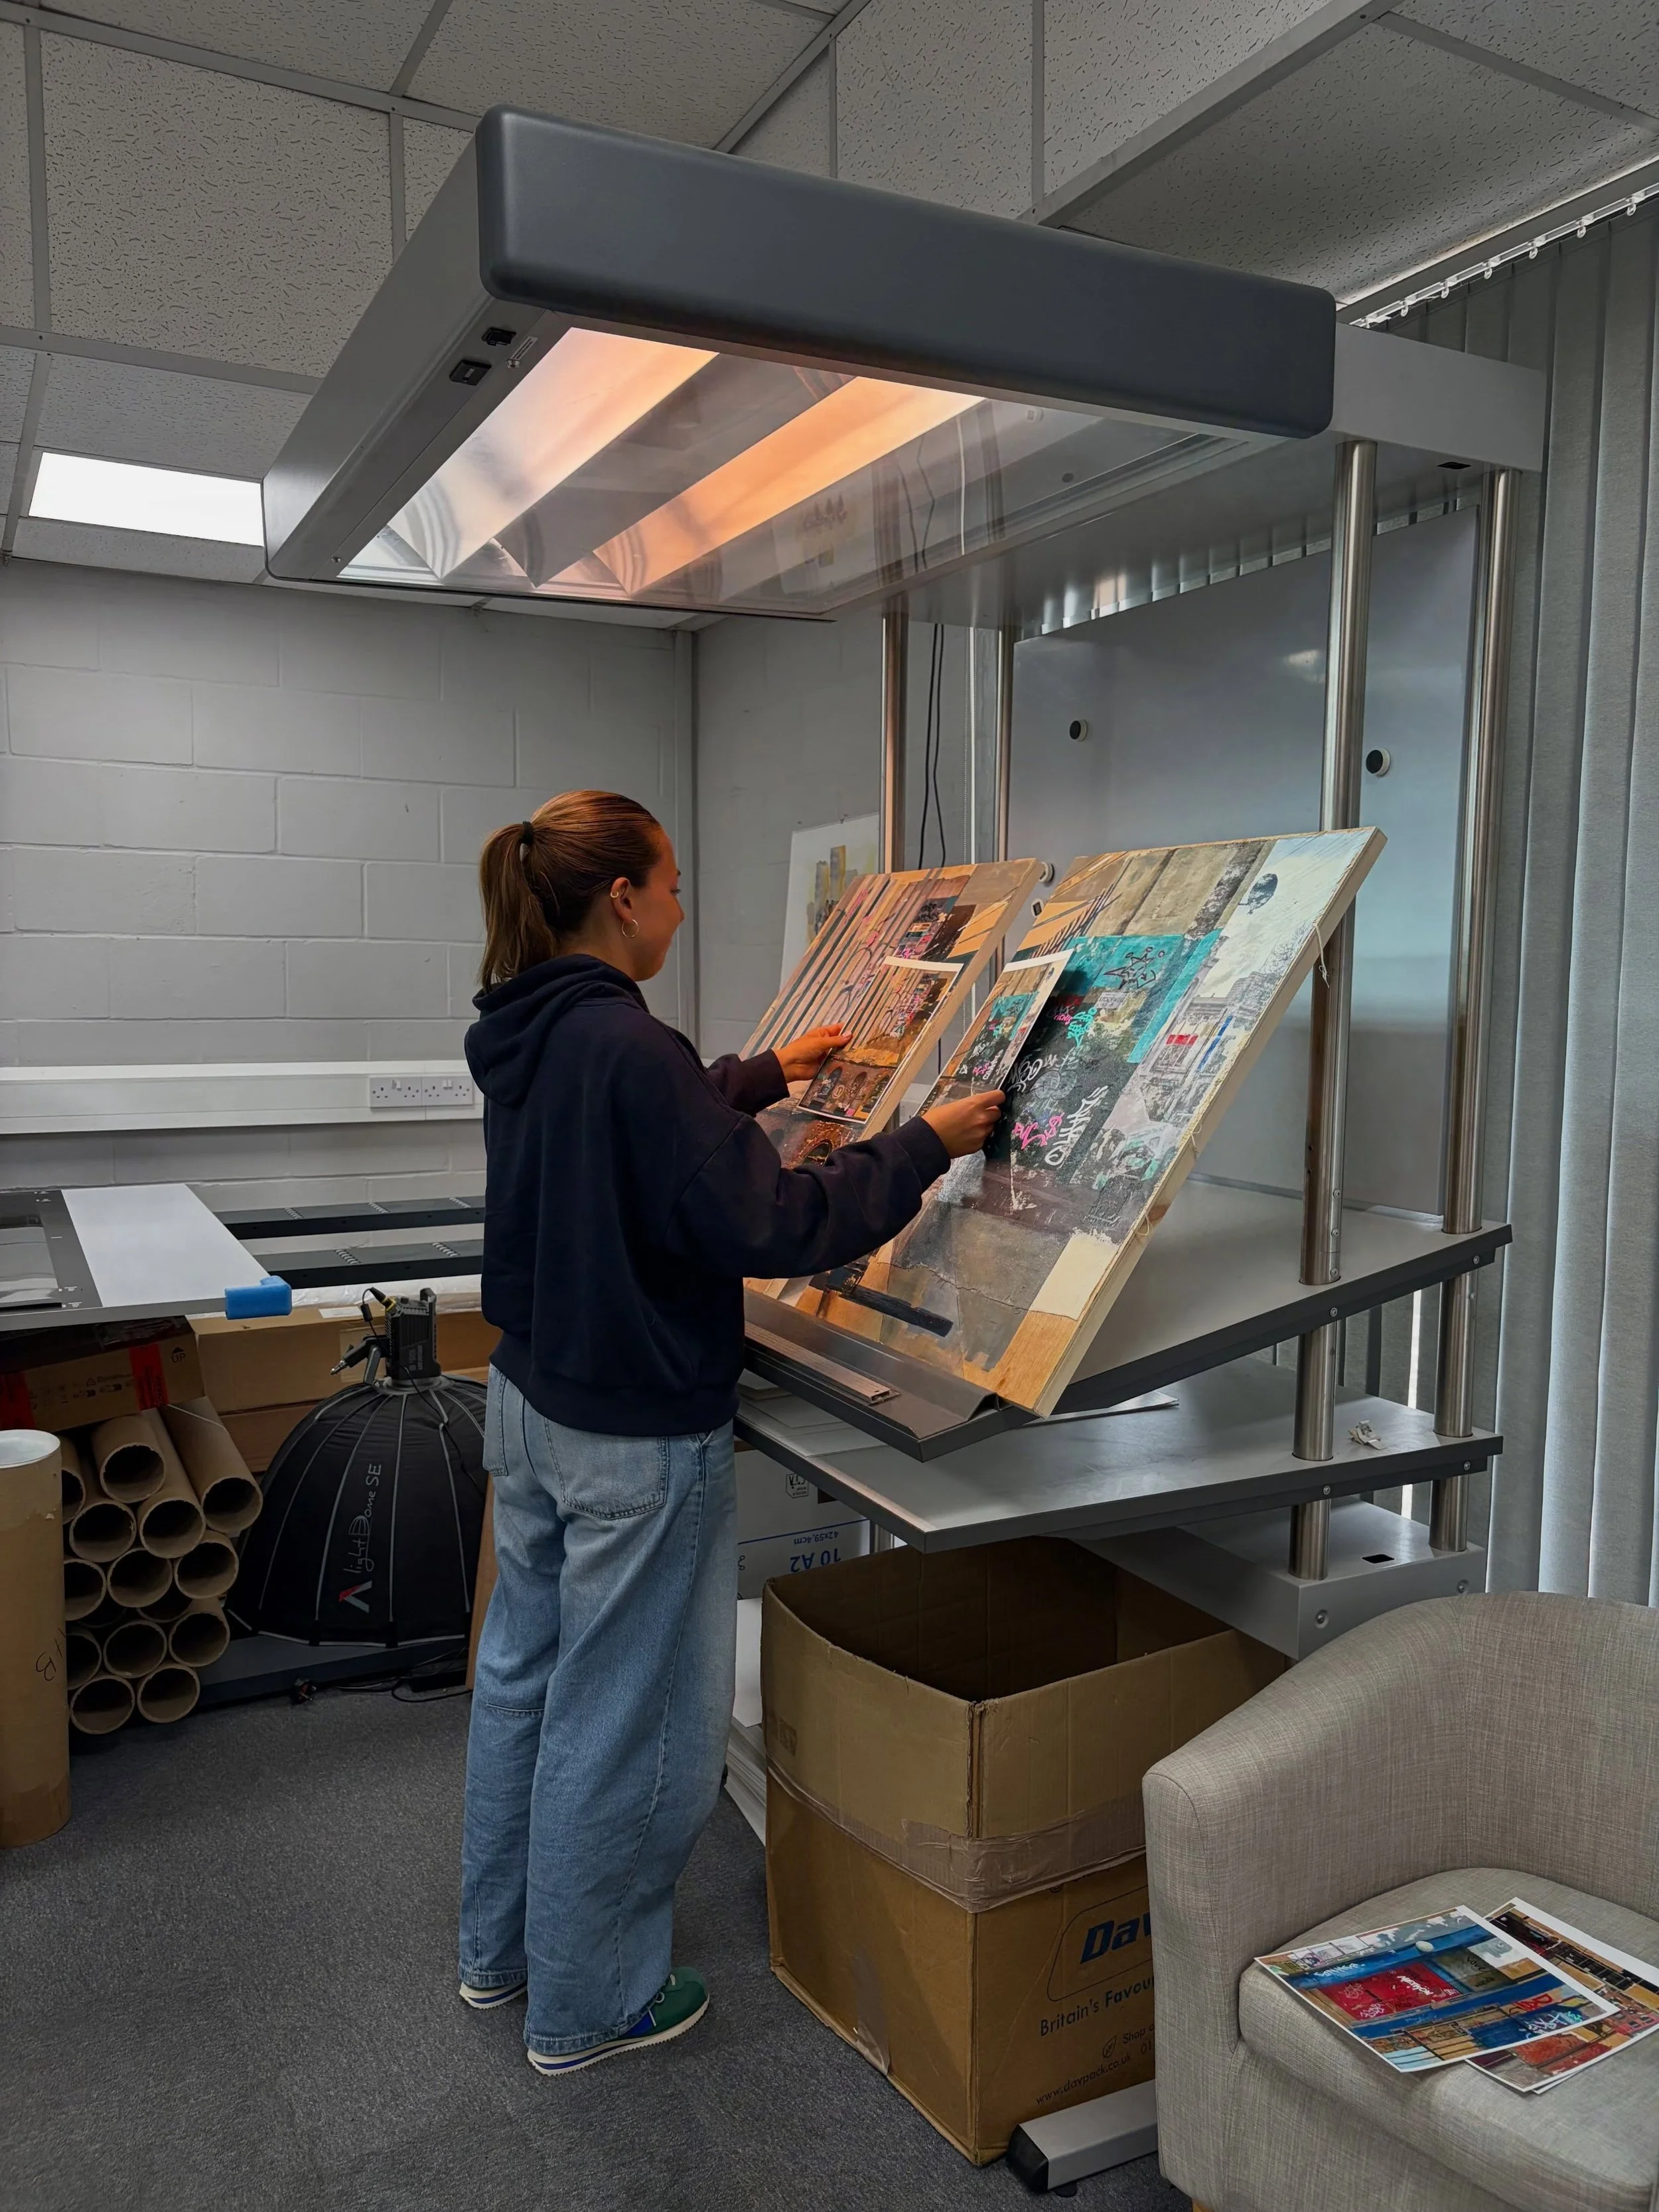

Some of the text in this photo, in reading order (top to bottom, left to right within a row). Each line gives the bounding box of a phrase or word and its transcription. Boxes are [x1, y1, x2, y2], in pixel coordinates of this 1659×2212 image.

[171, 1353, 186, 1363] UP
[366, 1463, 382, 1487] SE
[790, 1548, 841, 1572] 10 A2
[1041, 1998, 1099, 2037] Britain's
[1123, 2027, 1146, 2044] Shop
[1037, 2053, 1131, 2105] www.davpack.co.uk
